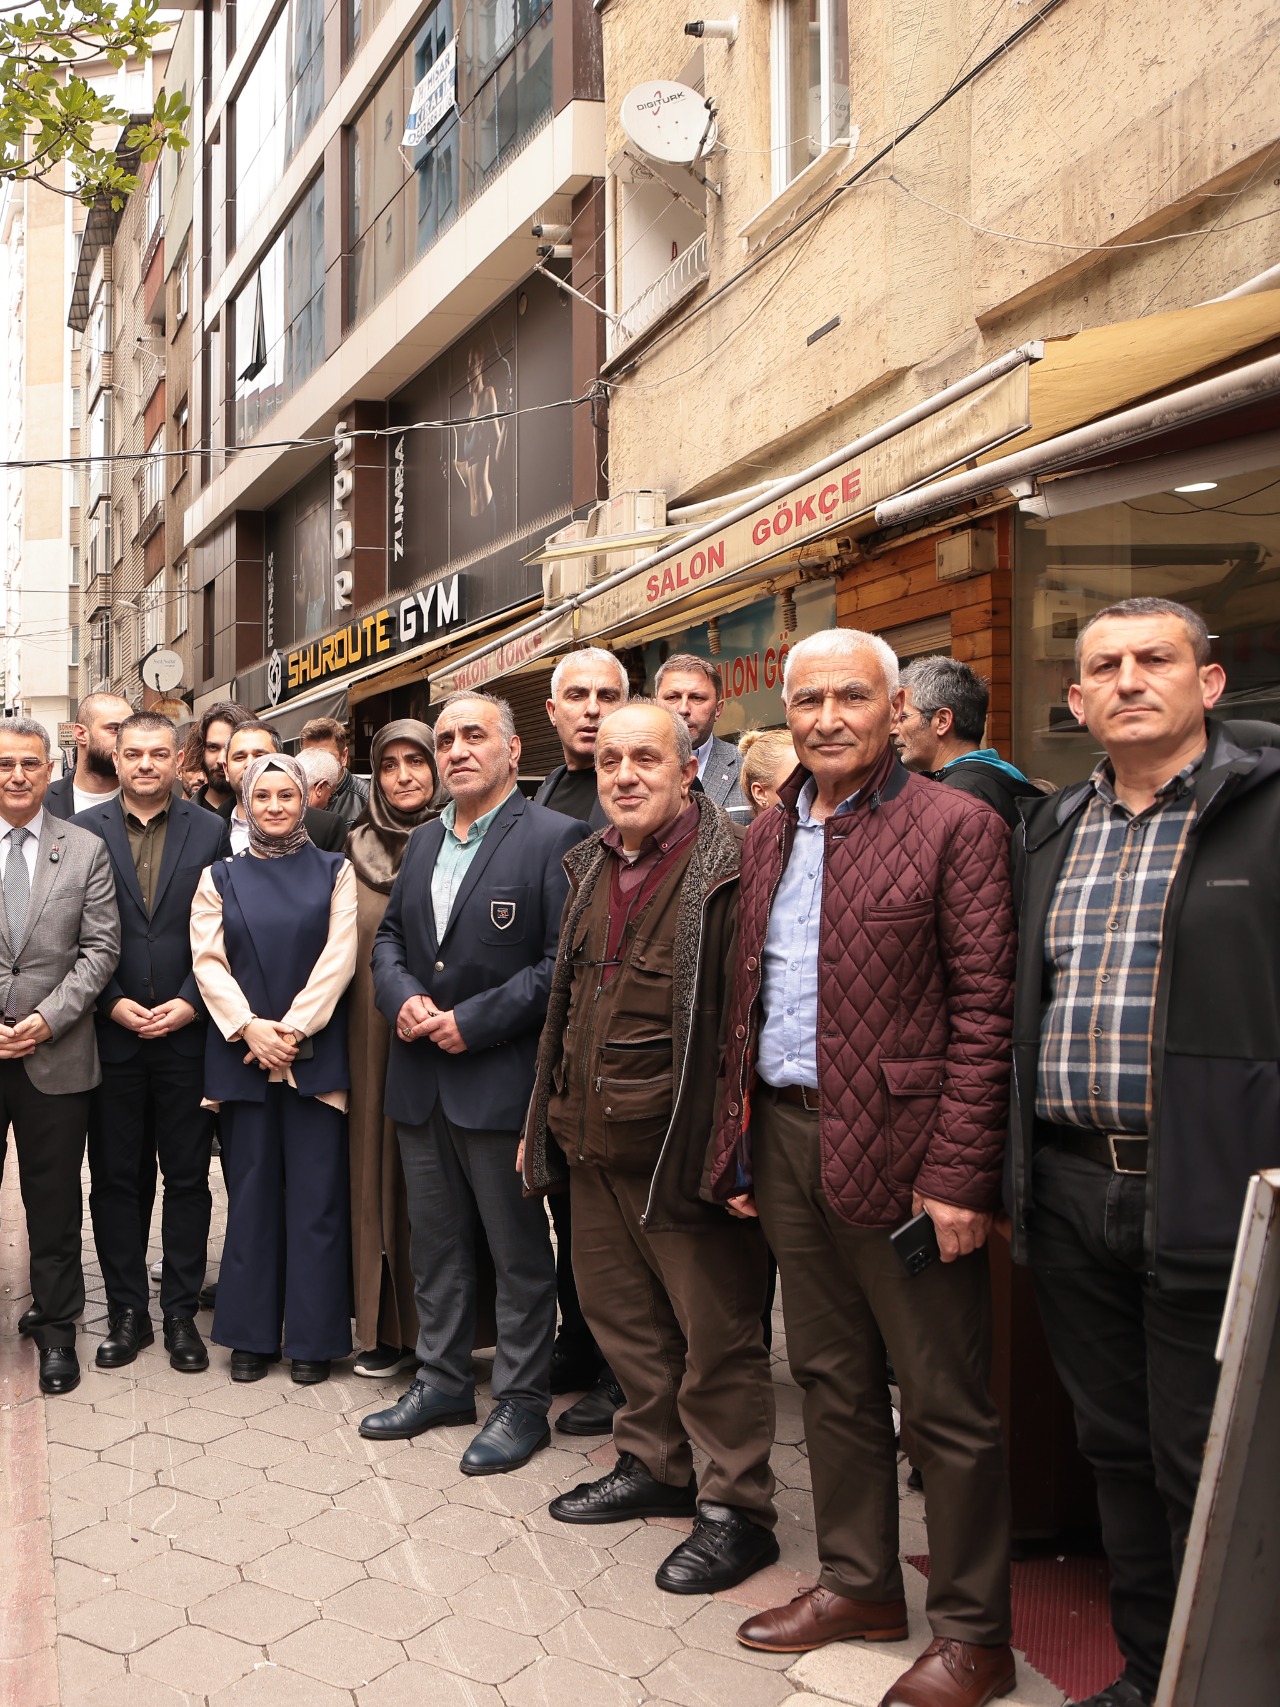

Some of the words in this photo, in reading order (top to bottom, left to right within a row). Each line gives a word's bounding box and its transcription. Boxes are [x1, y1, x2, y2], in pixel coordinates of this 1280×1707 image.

[333, 421, 354, 611] SPOR
[394, 434, 405, 562] ZUMBA
[751, 468, 863, 546] GÖKÇE
[646, 540, 726, 602] SALON
[287, 609, 391, 689] SHUROUTE
[399, 574, 460, 643] GYM
[452, 659, 489, 691] SALON
[717, 652, 759, 700] ALON
